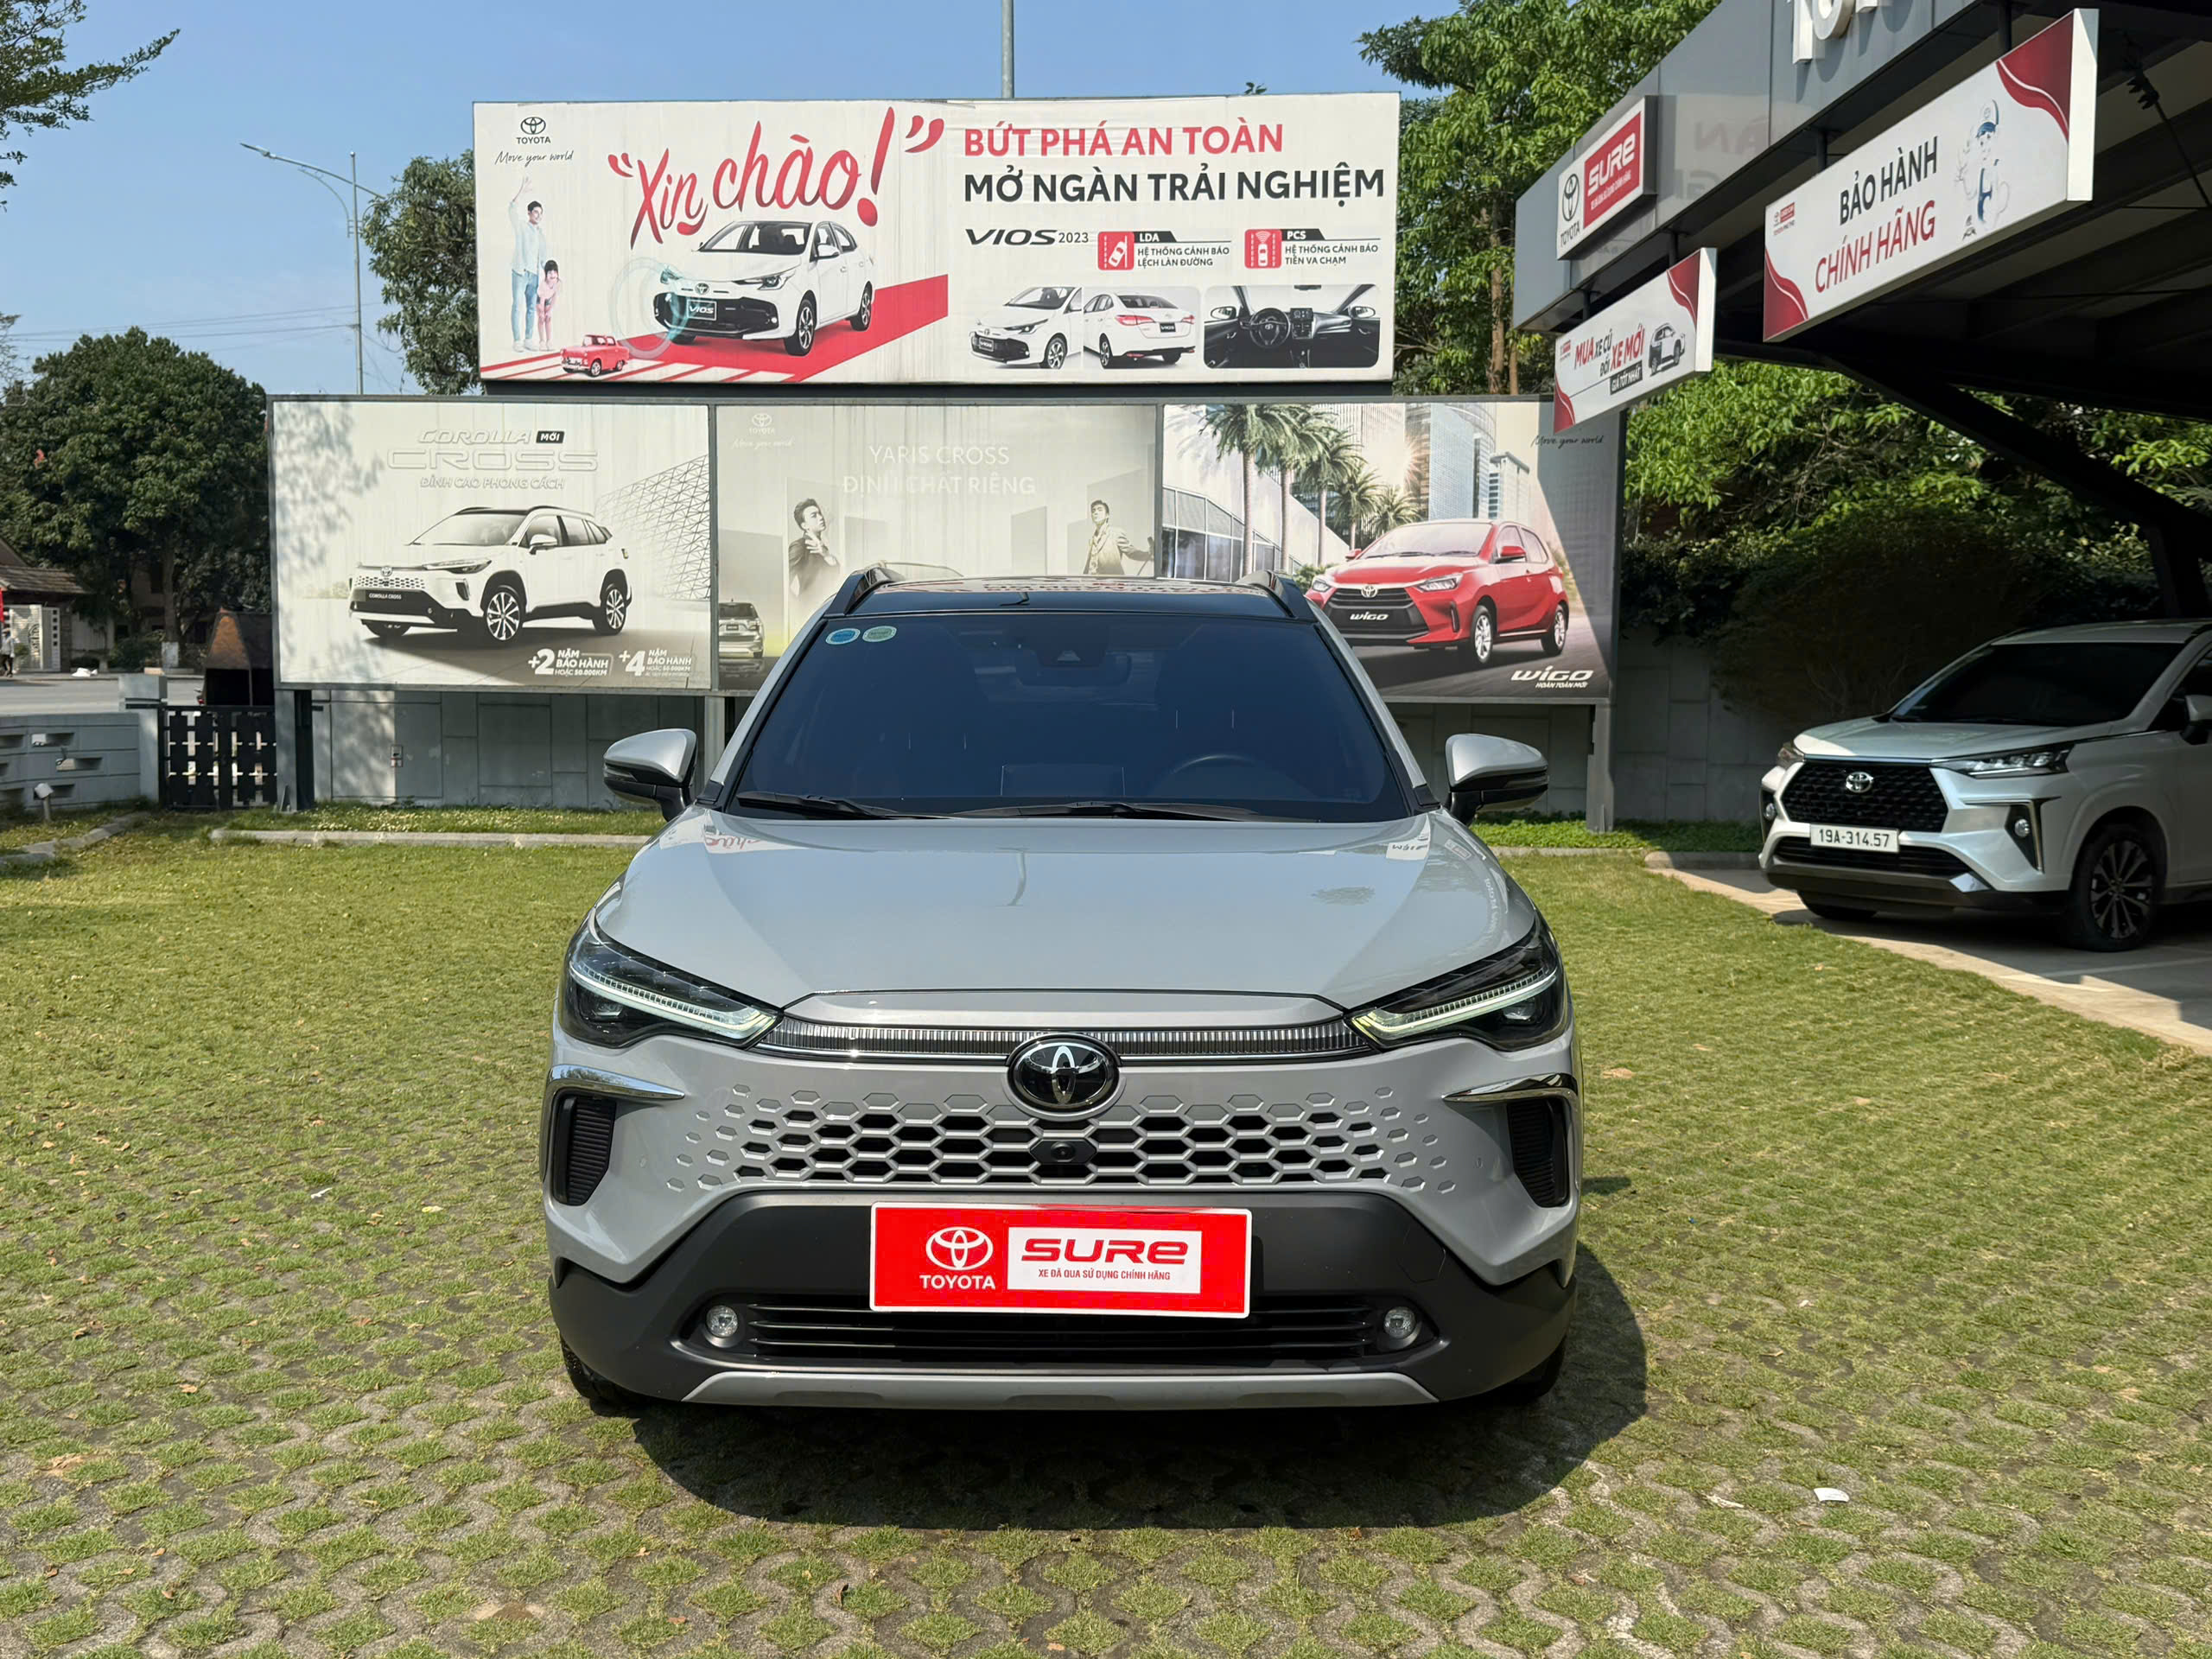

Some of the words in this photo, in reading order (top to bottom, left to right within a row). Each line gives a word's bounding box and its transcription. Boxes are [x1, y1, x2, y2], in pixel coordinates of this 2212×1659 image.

[964, 120, 1032, 157] BỨT
[1040, 119, 1113, 156] PHÁ
[1120, 127, 1173, 156] AN
[1182, 117, 1283, 155] TOÀN
[494, 150, 524, 165] Move
[524, 155, 547, 168] your
[549, 149, 575, 162] world
[964, 164, 1024, 202] MỞ
[1033, 166, 1138, 202] NGÀN
[1147, 162, 1225, 201] TRẢI
[1236, 162, 1384, 207] NGHIỆM
[1840, 169, 1876, 226] BẢO
[1880, 135, 1938, 202] HÀNH
[964, 229, 1058, 245] VIOS
[1058, 232, 1090, 244] 2023
[1139, 232, 1160, 243] LDA
[1287, 230, 1306, 240] PCS
[1560, 220, 1580, 248] TOYOTA
[1137, 246, 1149, 257] HỆ
[1151, 246, 1183, 257] THỐNG
[1184, 245, 1210, 256] CẢNH
[1285, 245, 1297, 256] HỆ
[1299, 244, 1331, 254] THỐNG
[1332, 243, 1357, 253] CẢNH
[1815, 234, 1873, 293] CHÍNH
[1876, 200, 1936, 264] HÃNG
[1137, 257, 1160, 269] LỆCH
[1160, 257, 1179, 267] LÀN
[1319, 257, 1347, 267] CHẠM
[689, 305, 715, 314] VIOS
[1574, 336, 1594, 370] MUA
[1594, 338, 1603, 358] XE
[1610, 340, 1624, 372] XE
[1624, 322, 1645, 364] MỚI
[417, 429, 532, 445] COROLLA
[540, 431, 560, 442] MỚI
[386, 448, 599, 472] CROSS
[868, 445, 930, 465] YARIS
[936, 445, 1010, 465] CROSS
[454, 476, 480, 488] CAO
[482, 477, 528, 489] PHONG
[530, 474, 566, 489] CÁCH
[968, 471, 1036, 494] RIÊNG
[557, 647, 580, 658] NĂM
[665, 655, 692, 665] HÀNH
[527, 647, 556, 675] +2
[556, 657, 578, 669] BẢO
[578, 657, 609, 669] HÀNH
[618, 650, 646, 677] +4
[1819, 828, 1890, 848] 19A-314.57
[918, 1274, 996, 1290] TOYOTA
[1038, 1268, 1049, 1278] XE
[1050, 1267, 1062, 1279] ĐÃ
[1064, 1268, 1081, 1279] QUA
[1082, 1267, 1094, 1279] SỬ
[1096, 1270, 1119, 1281] DỤNG
[1121, 1268, 1147, 1280] CHÍNH
[1147, 1269, 1171, 1281] HÃNG
